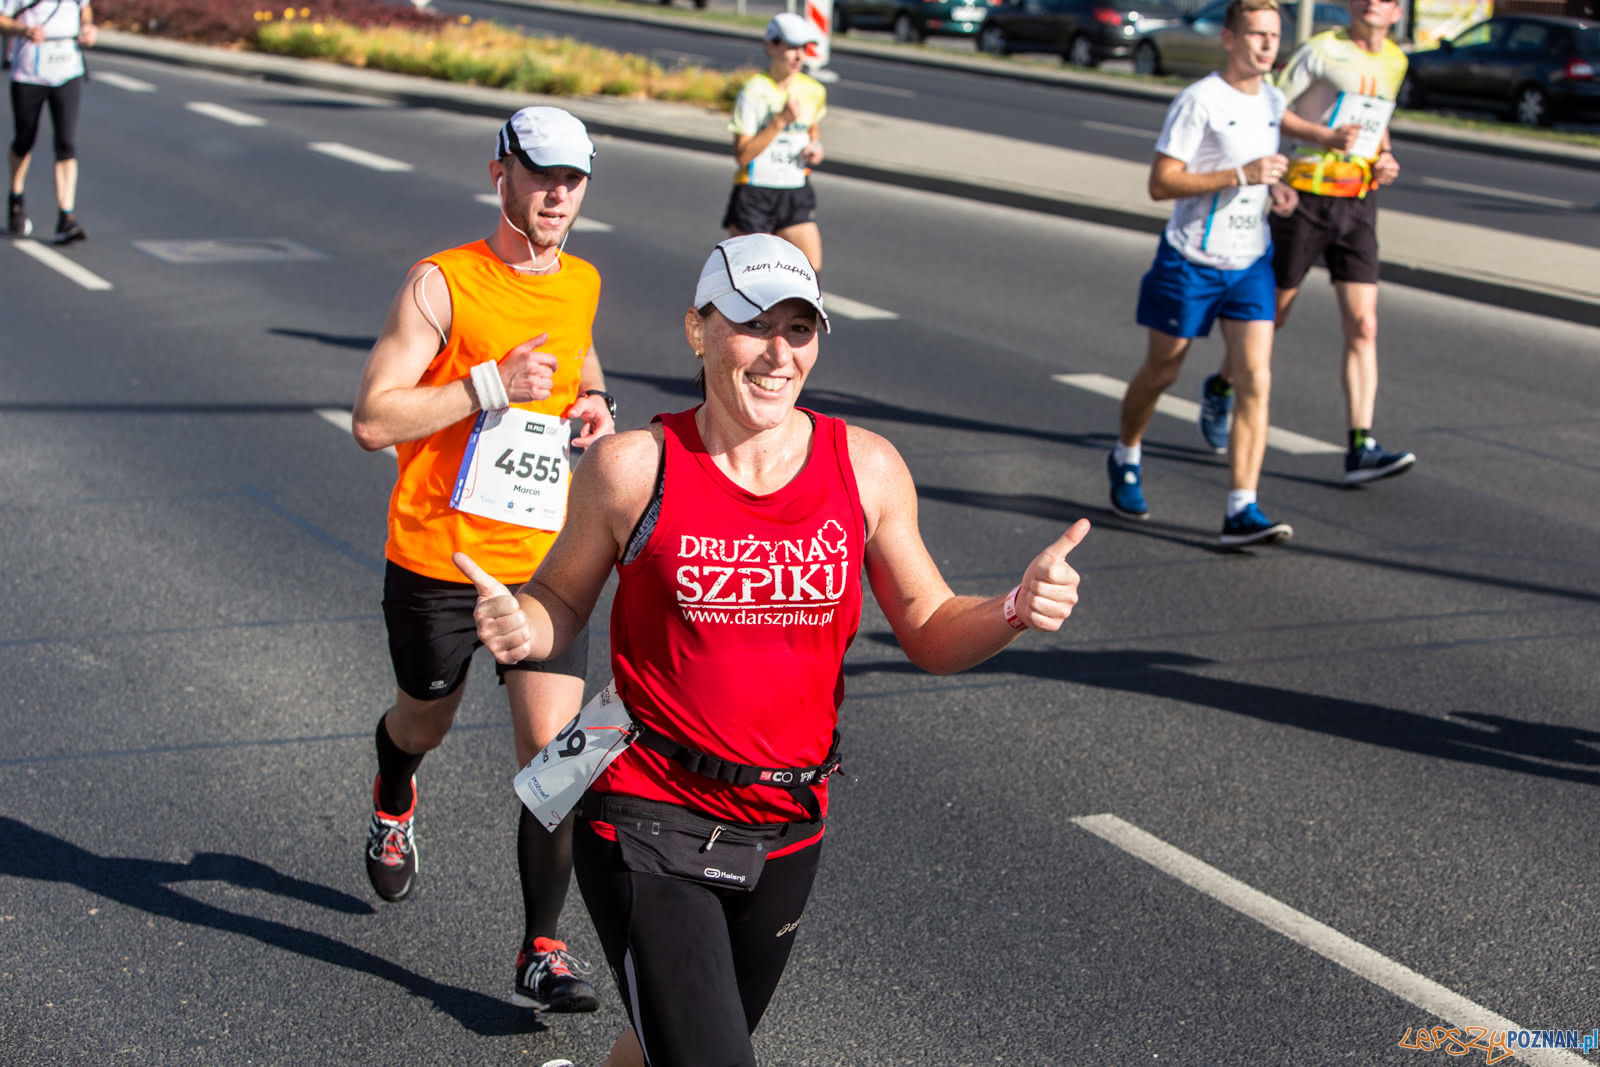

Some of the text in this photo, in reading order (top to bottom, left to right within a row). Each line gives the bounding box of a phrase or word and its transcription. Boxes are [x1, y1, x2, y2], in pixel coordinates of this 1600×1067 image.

[742, 260, 811, 281] run happy
[494, 448, 561, 484] 4555
[513, 484, 540, 496] Marcin
[677, 533, 827, 563] DRUŻYNA
[676, 561, 849, 603] SZPIKU
[682, 608, 834, 627] www.darszpiku.pl
